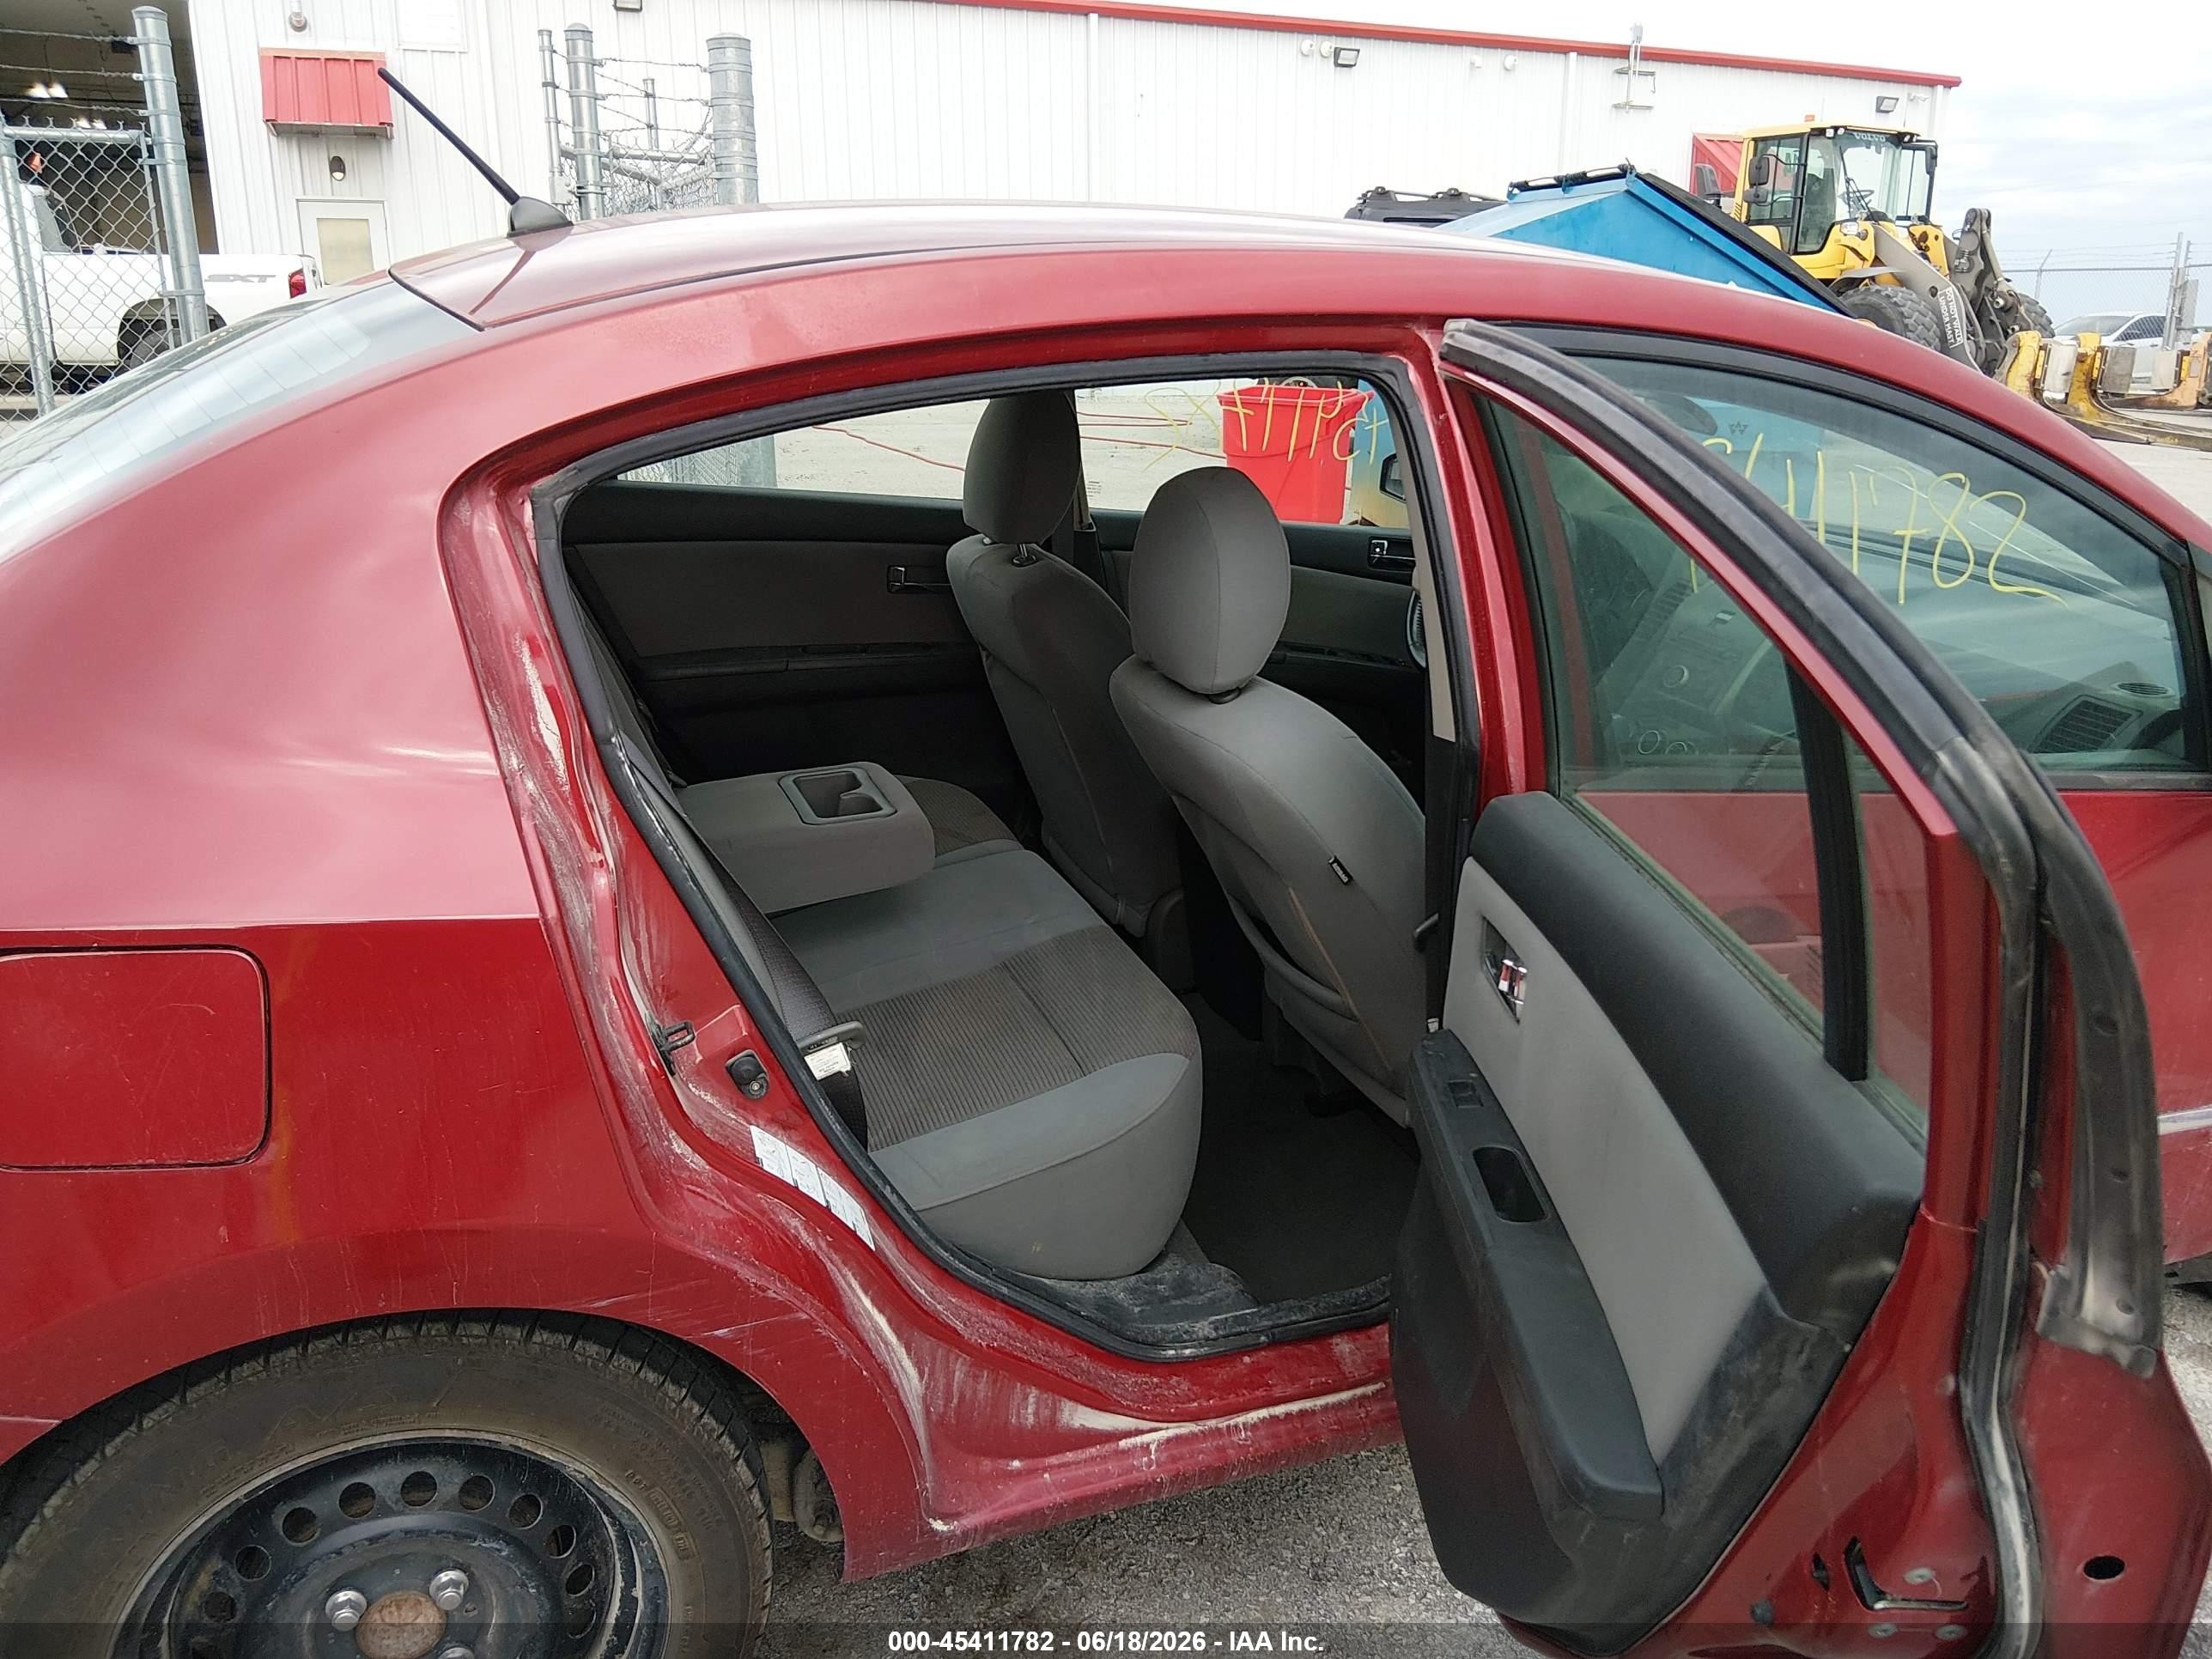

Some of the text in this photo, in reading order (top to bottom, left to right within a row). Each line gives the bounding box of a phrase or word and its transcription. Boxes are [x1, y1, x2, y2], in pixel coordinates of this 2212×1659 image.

[1855, 132, 1887, 143] VOLVO
[1937, 295, 1954, 344] UNDER MAST
[1945, 289, 1963, 343] DO NOT WALK
